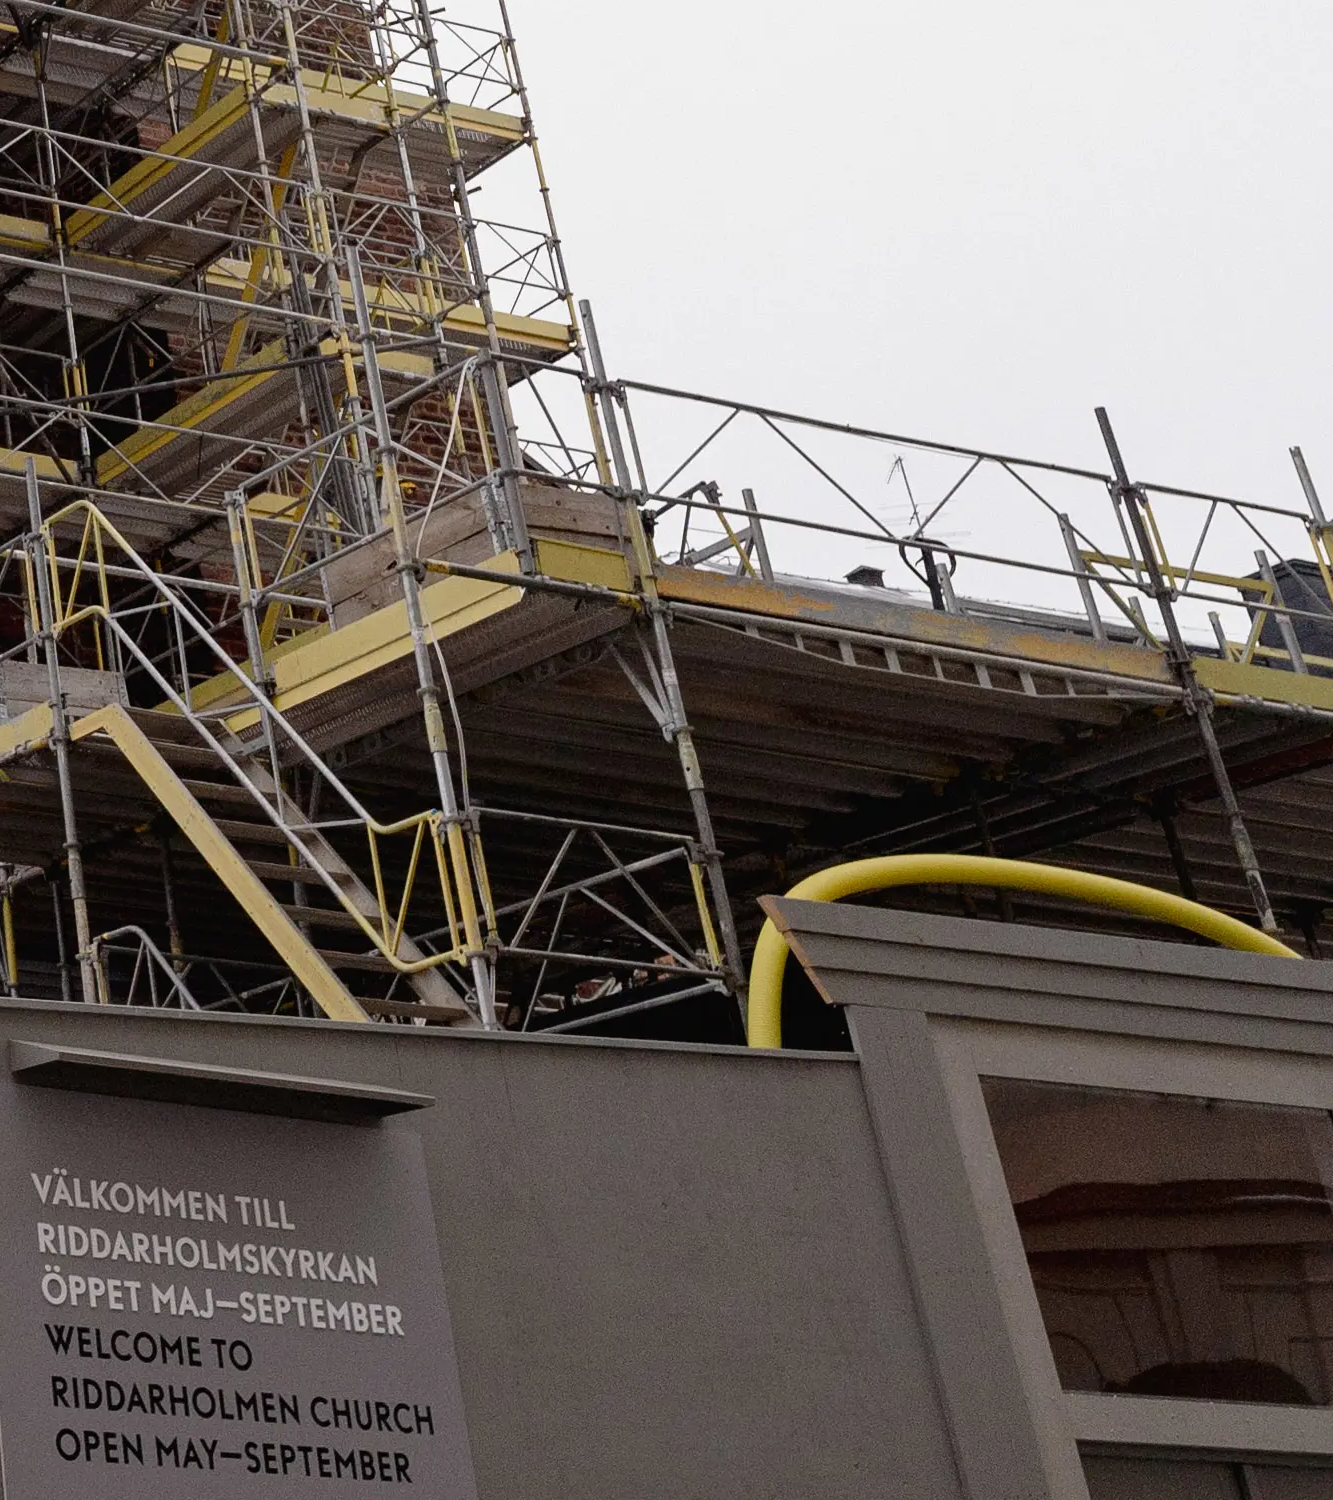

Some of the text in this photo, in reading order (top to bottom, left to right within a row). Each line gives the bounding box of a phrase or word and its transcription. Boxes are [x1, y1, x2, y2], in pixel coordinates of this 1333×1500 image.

[30, 1166, 296, 1230] VÄLKOMMEN TILL
[36, 1221, 378, 1285] RIDDARHOLMSKYRKAN
[40, 1263, 141, 1311] ÖPPET
[44, 1323, 253, 1371] WELCOME TO
[50, 1375, 434, 1435] RIDDARHOLMEN CHURCH
[55, 1427, 144, 1464] OPEN
